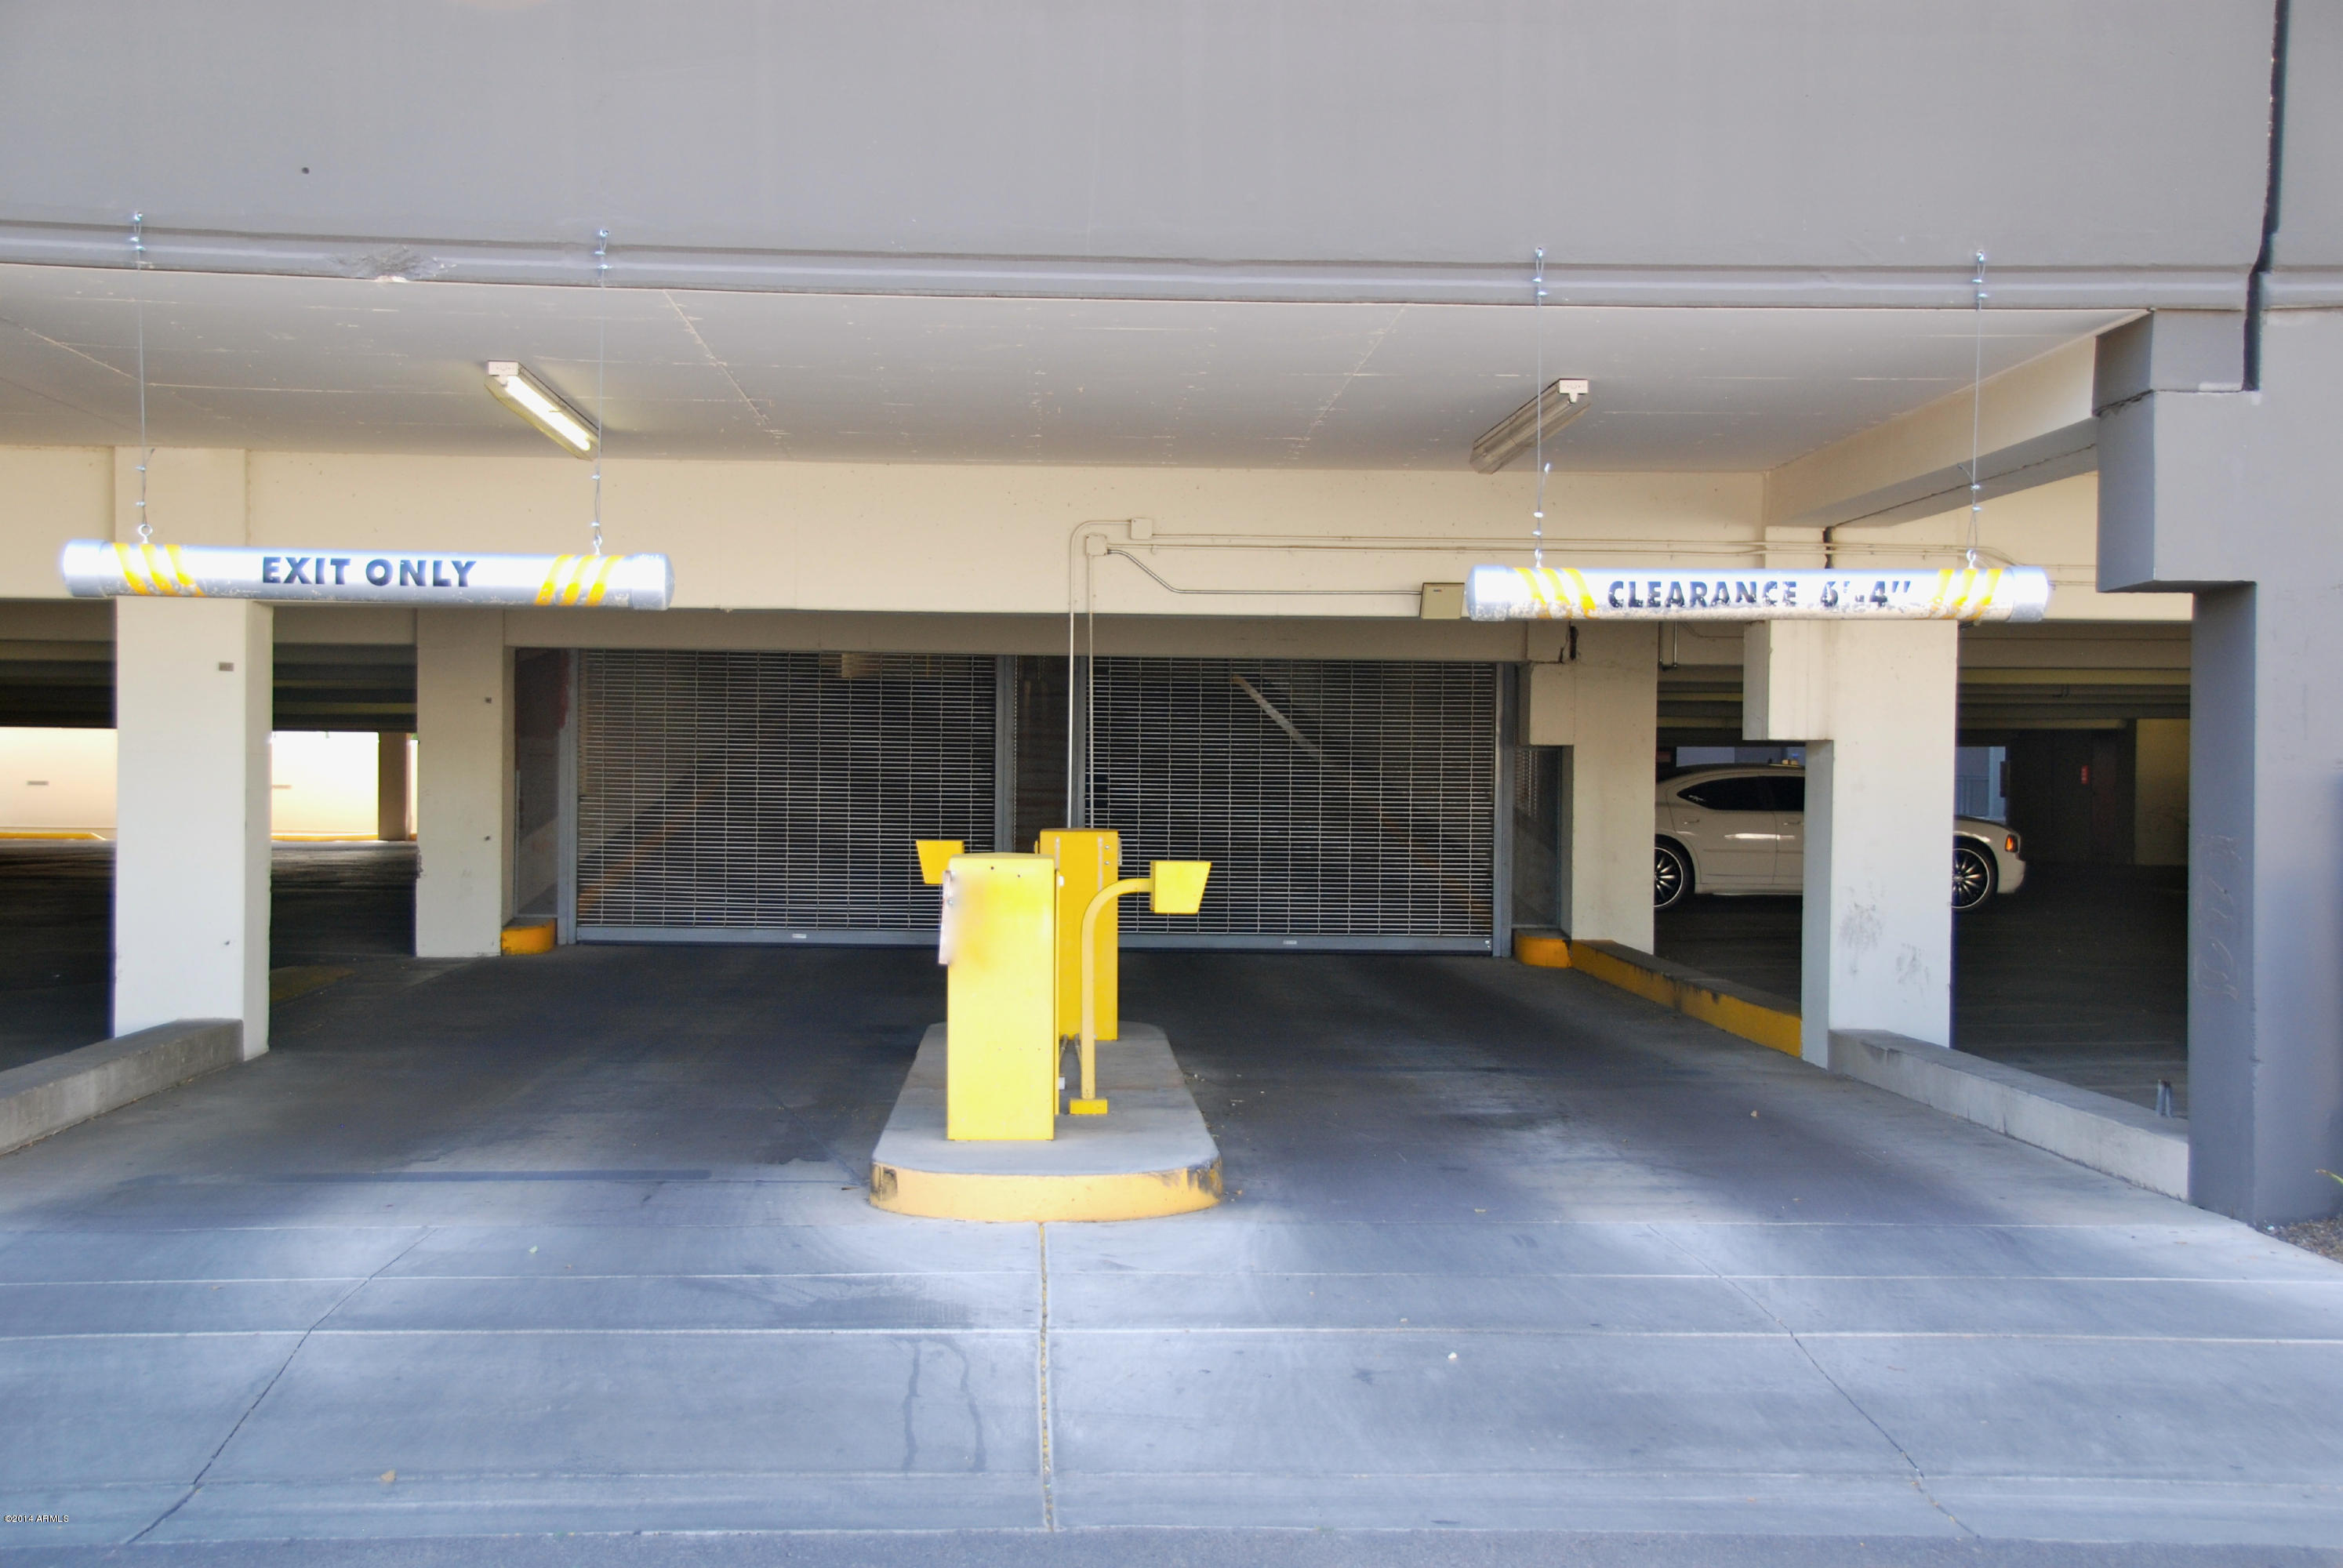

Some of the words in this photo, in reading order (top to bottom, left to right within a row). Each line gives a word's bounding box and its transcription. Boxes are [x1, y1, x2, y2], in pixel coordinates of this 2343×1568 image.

[262, 556, 352, 586] EXIT
[365, 557, 477, 587] ONLY
[1607, 580, 1798, 608] CLEARANCE
